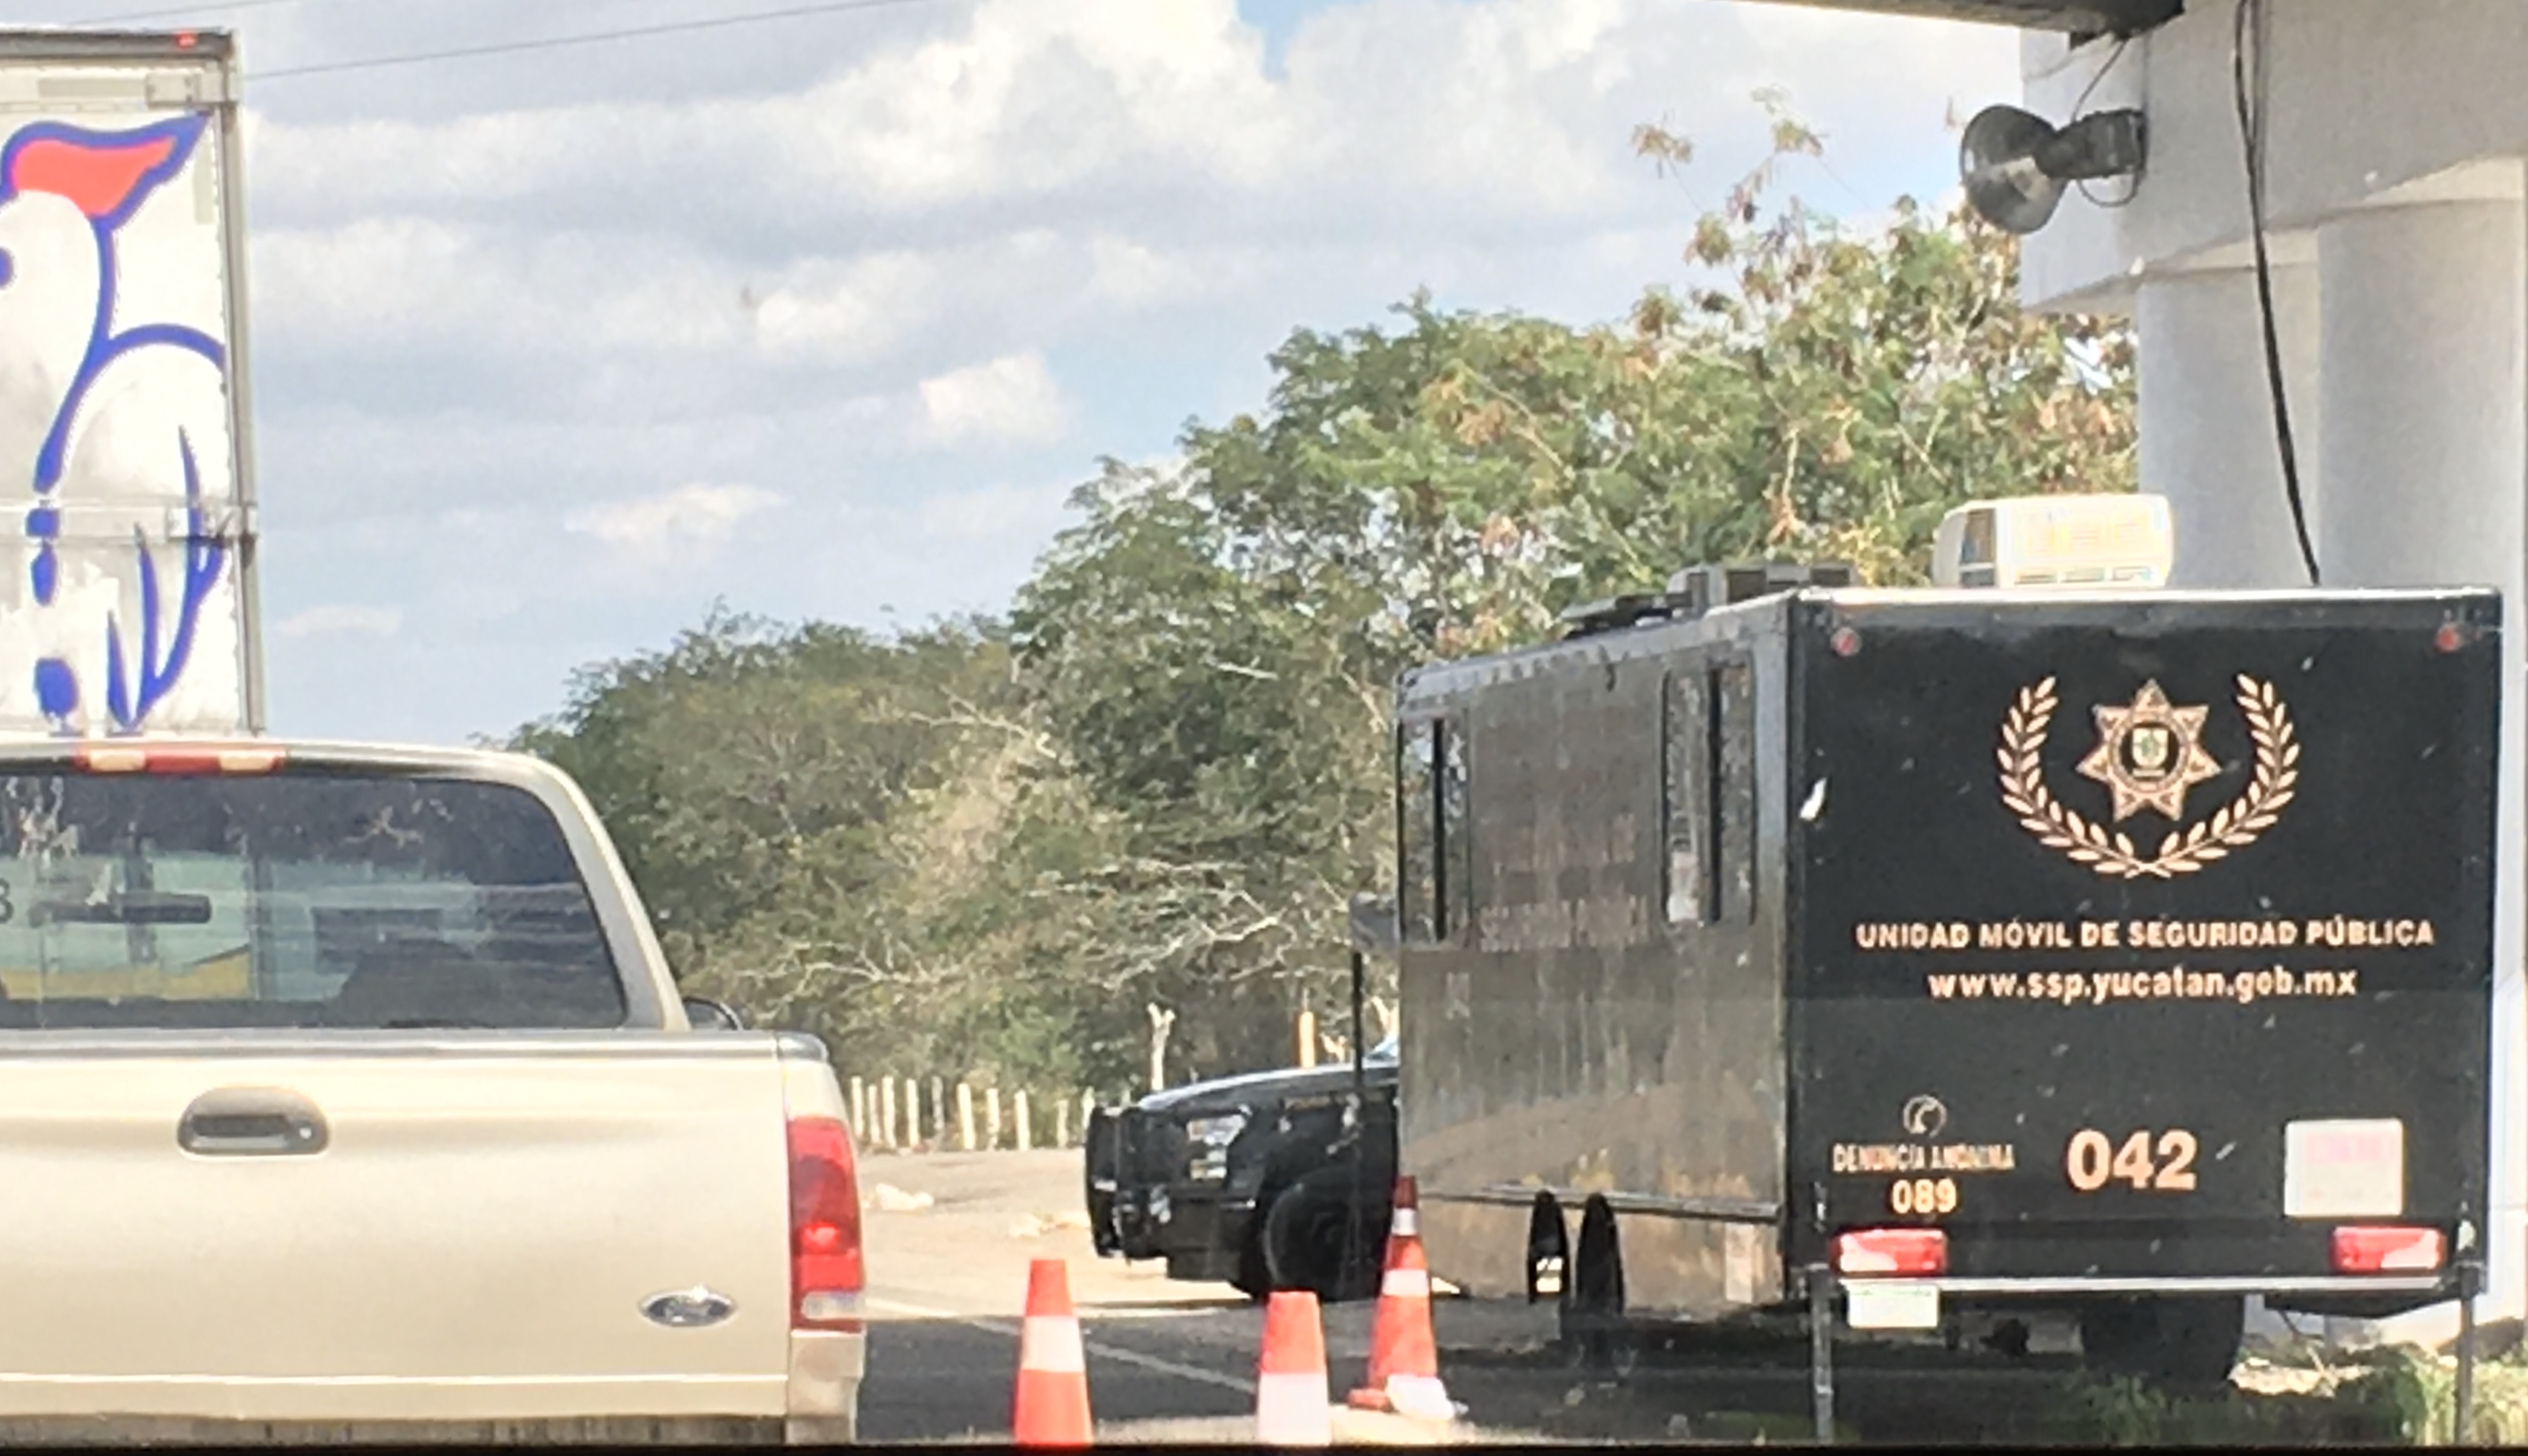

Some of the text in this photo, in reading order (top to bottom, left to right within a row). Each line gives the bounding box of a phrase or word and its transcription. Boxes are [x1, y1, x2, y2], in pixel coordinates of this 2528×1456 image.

[1855, 914, 2434, 948] UNIDAD MÓVIL DE SEGURIDAD PÚBLICA
[1927, 963, 2358, 1005] www.ssp.yucatan.gob.mx
[2068, 1129, 2197, 1190] 042
[1892, 1178, 1957, 1214] 089
